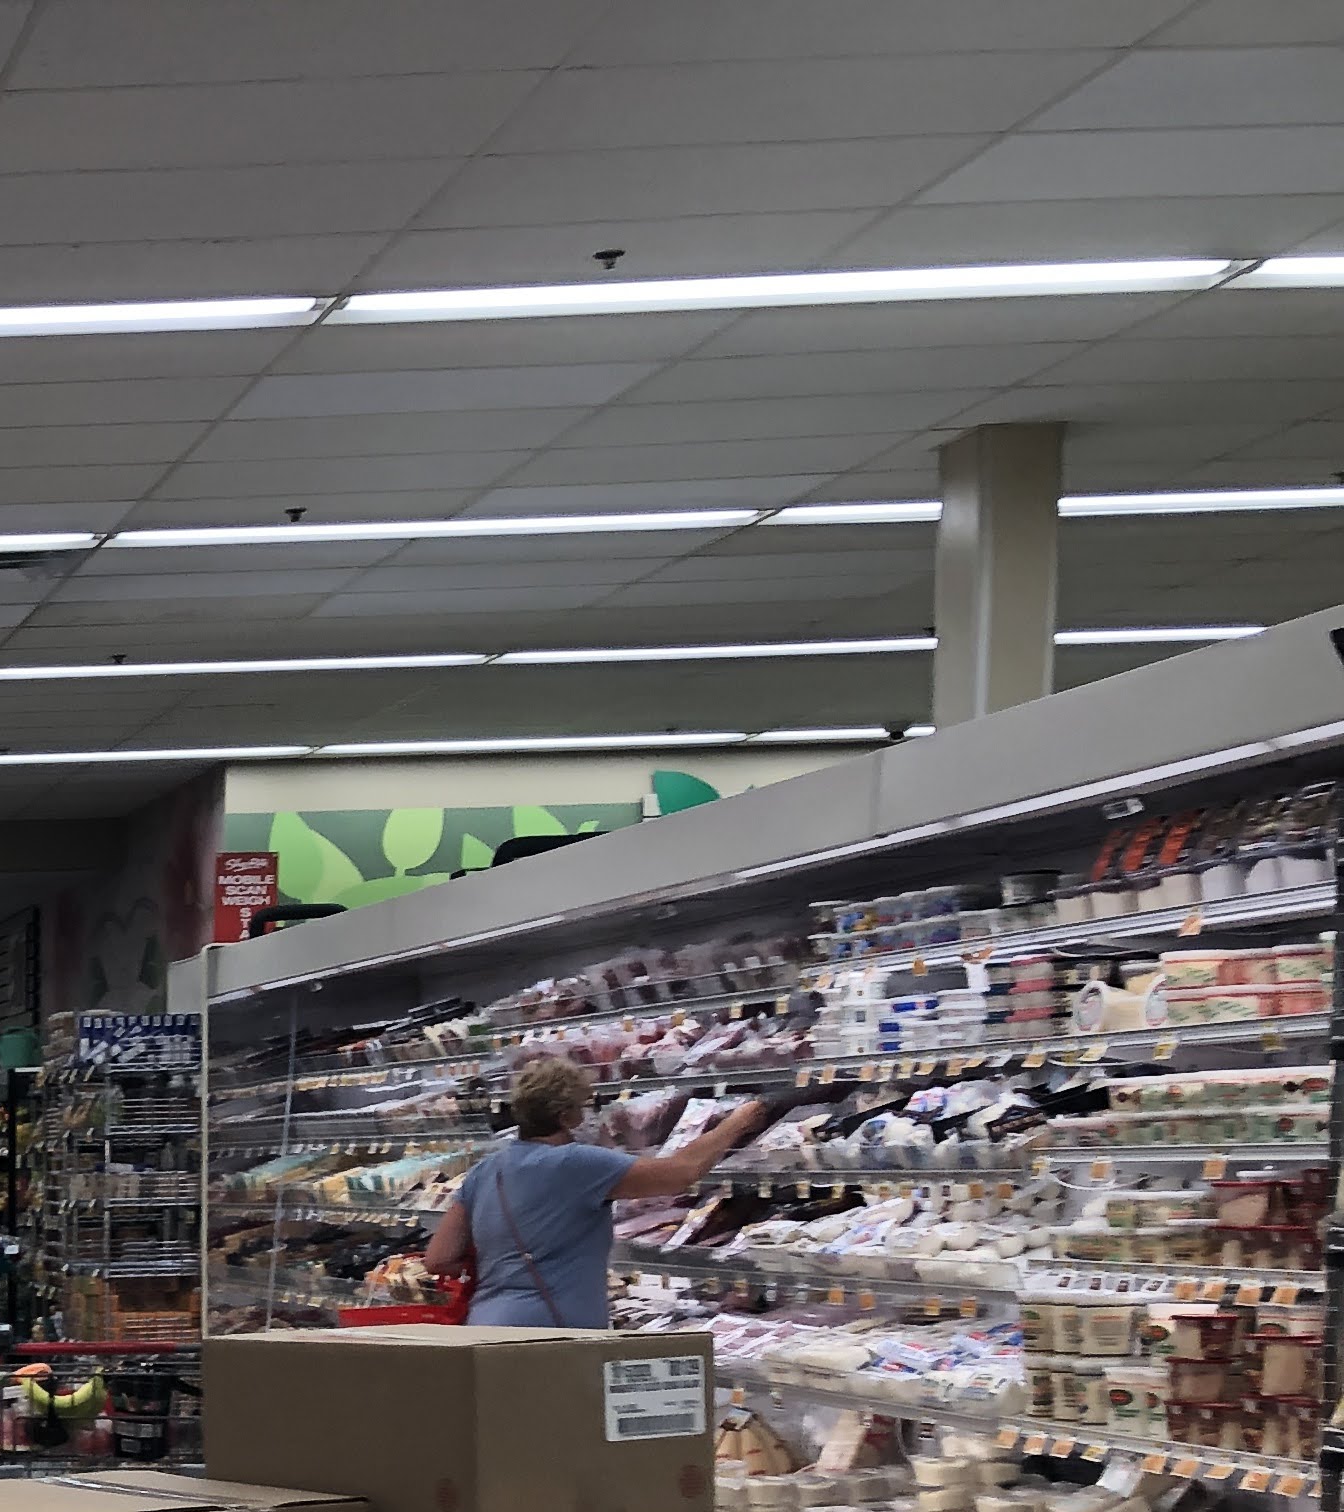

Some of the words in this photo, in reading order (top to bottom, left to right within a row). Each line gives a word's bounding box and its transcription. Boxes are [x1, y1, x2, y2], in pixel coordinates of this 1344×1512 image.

[218, 874, 275, 886] MOBILE
[225, 885, 268, 896] SCAN
[221, 895, 271, 906] WEIGH
